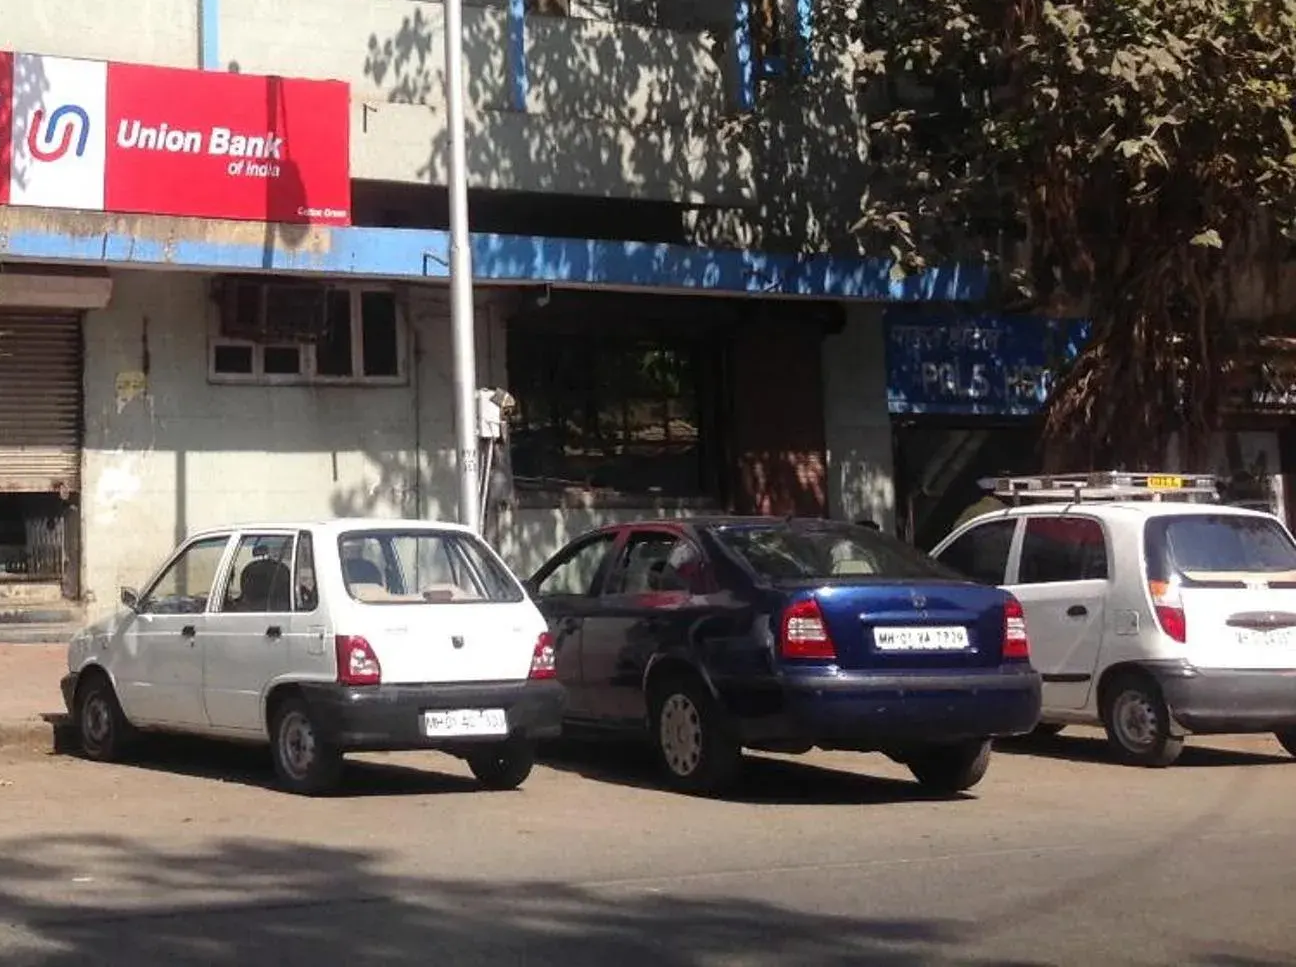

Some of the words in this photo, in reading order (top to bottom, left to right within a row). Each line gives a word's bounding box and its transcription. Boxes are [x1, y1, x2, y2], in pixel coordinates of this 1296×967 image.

[116, 118, 202, 153] Union
[208, 127, 282, 159] Bank
[228, 160, 244, 176] of
[245, 161, 281, 178] India
